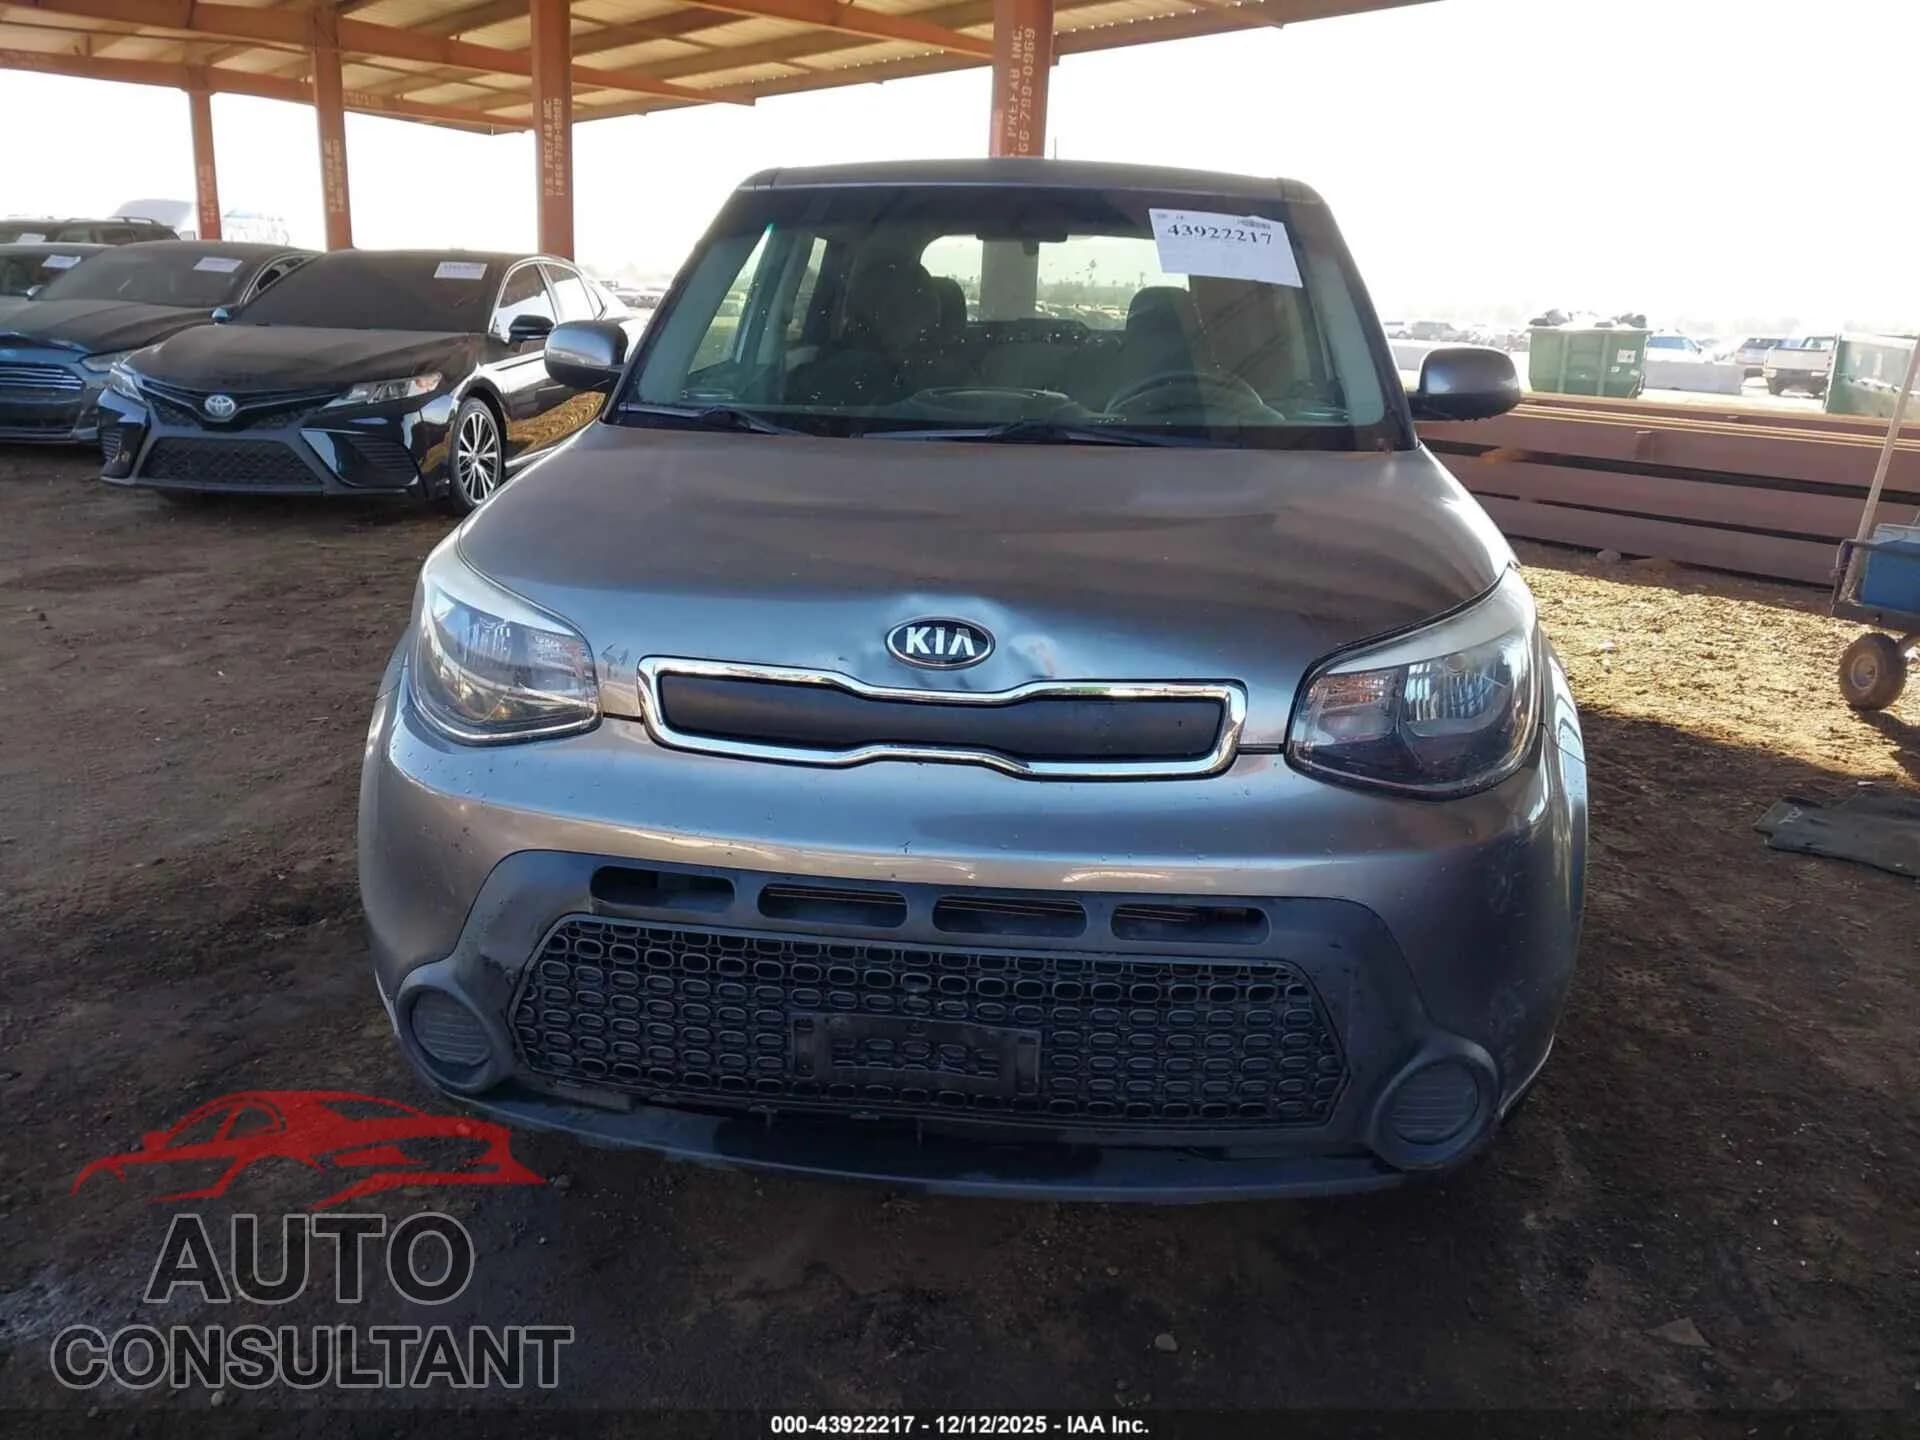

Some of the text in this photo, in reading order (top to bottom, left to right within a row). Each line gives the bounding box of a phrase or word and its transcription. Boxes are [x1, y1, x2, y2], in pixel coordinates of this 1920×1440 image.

[1018, 27, 1036, 153] 66-799-0969
[1167, 224, 1273, 245] 43922217
[905, 626, 976, 657] KIA
